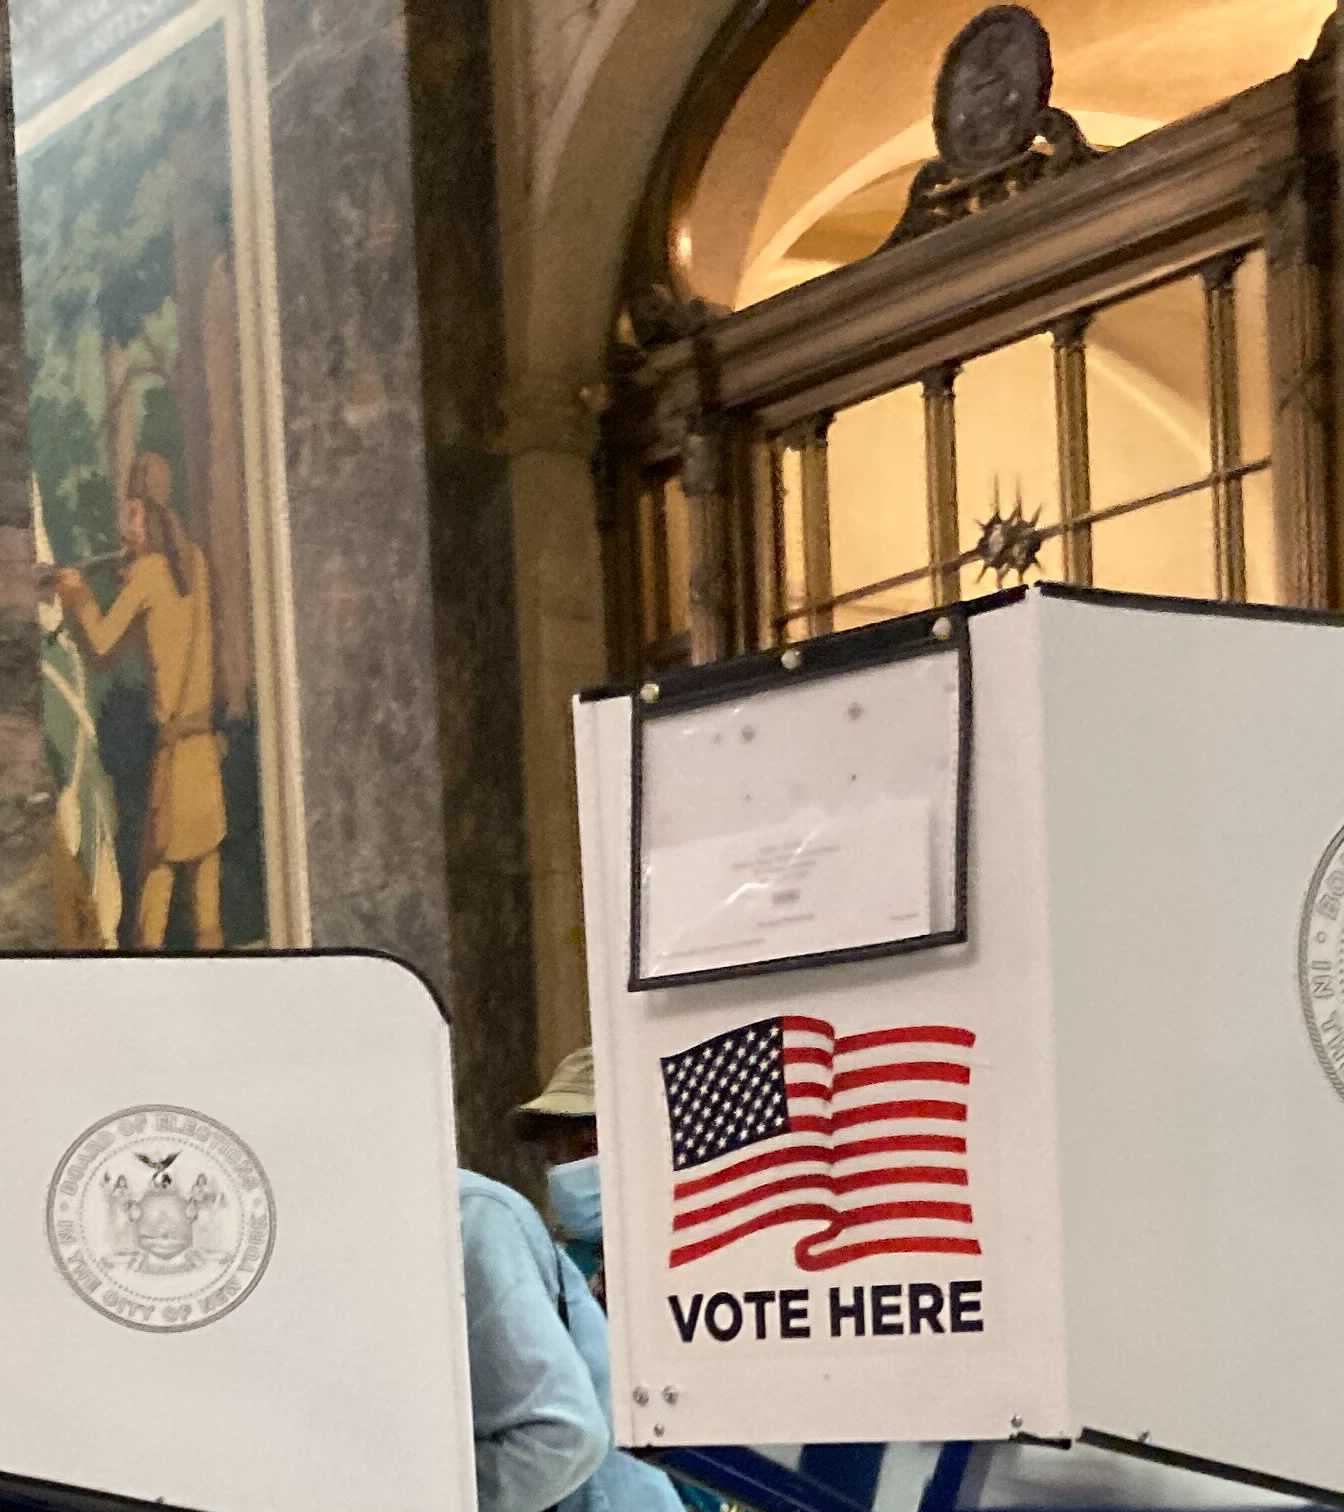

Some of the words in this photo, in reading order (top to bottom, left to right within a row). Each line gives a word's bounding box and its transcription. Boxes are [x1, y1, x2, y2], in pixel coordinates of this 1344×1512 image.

[1310, 959, 1336, 1000] IN
[668, 1287, 811, 1343] VOTE
[829, 1280, 985, 1338] HERE
